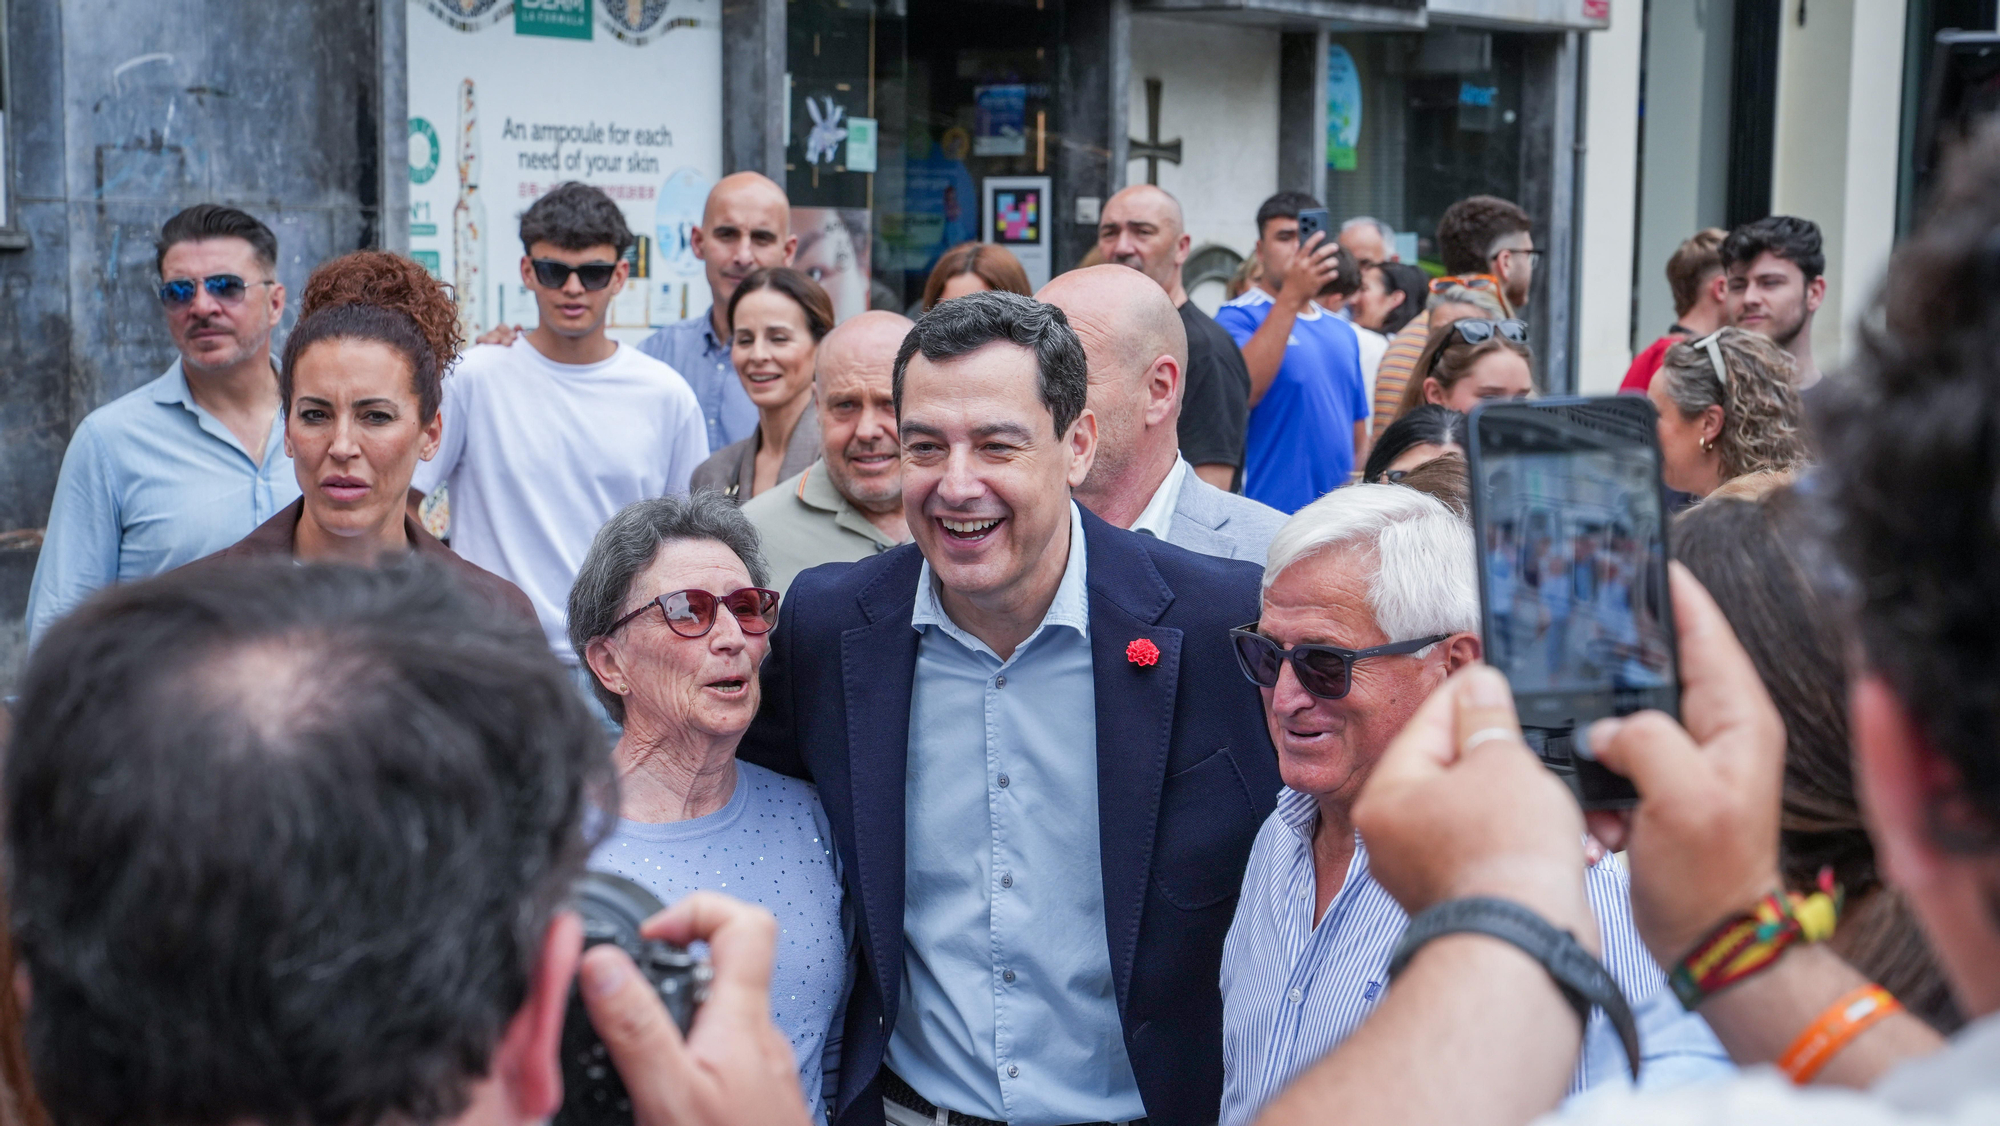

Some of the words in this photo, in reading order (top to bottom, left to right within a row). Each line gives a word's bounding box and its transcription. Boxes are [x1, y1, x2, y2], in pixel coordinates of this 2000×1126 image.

[502, 116, 527, 140] An
[531, 119, 605, 148] ampoule
[608, 121, 631, 146] for
[634, 124, 674, 148] each
[517, 150, 560, 171] need
[564, 149, 582, 171] of
[584, 154, 625, 178] your
[627, 150, 660, 174] skin
